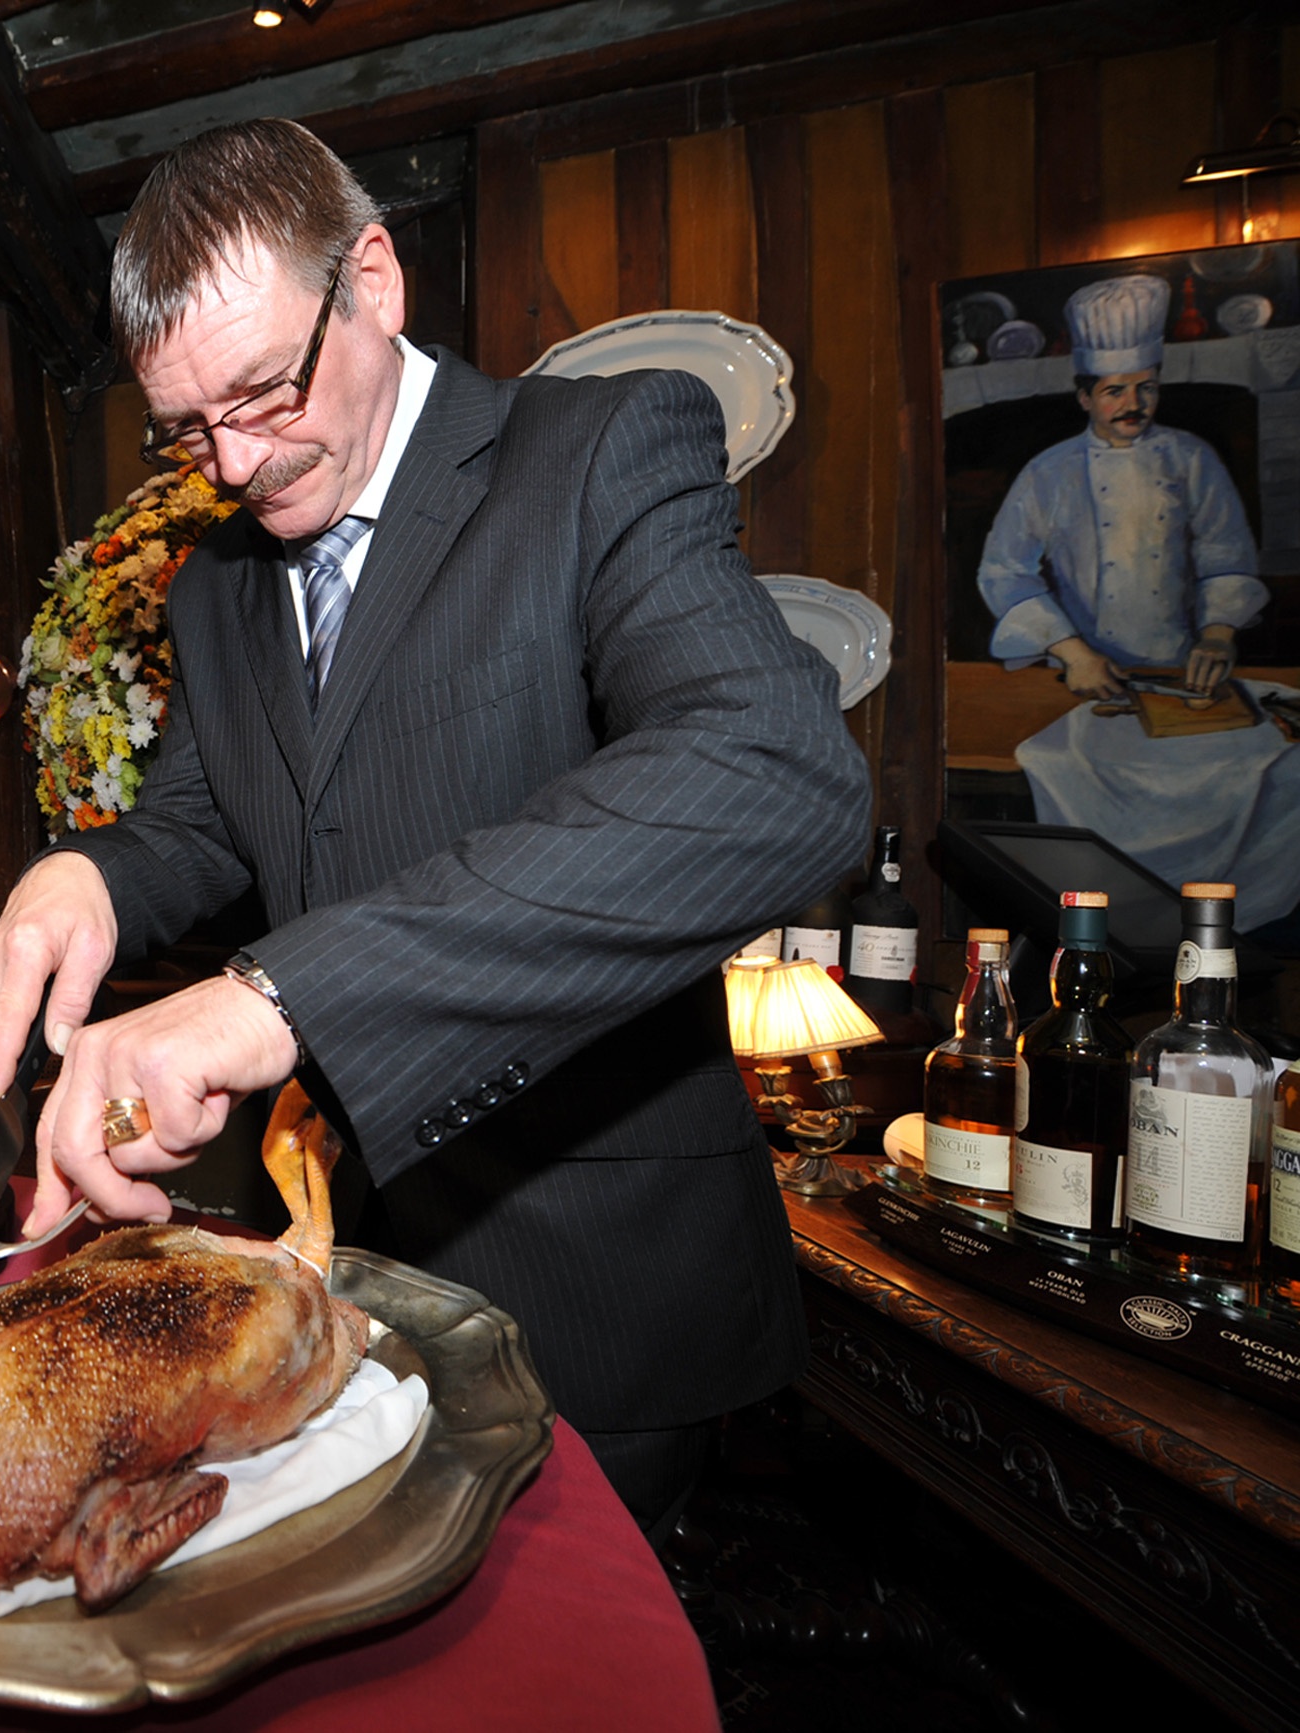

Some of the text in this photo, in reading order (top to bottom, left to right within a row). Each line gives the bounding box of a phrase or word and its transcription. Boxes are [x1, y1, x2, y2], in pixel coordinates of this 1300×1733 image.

[965, 1159, 981, 1171] 12
[877, 1196, 921, 1221] GLENKINCHIE
[939, 1226, 992, 1253] LAGAVULIN
[1045, 1279, 1068, 1292] YEARS
[1069, 1288, 1086, 1299] OLD
[1047, 1270, 1085, 1288] OBAN
[1028, 1280, 1087, 1305] WEST HIGHLAND
[1129, 1298, 1165, 1309] CLASSIC
[1166, 1304, 1187, 1324] MALTS
[1127, 1316, 1172, 1338] SELECTION
[1244, 1359, 1291, 1383] SPEYSIDE
[1253, 1356, 1283, 1372] YEARS
